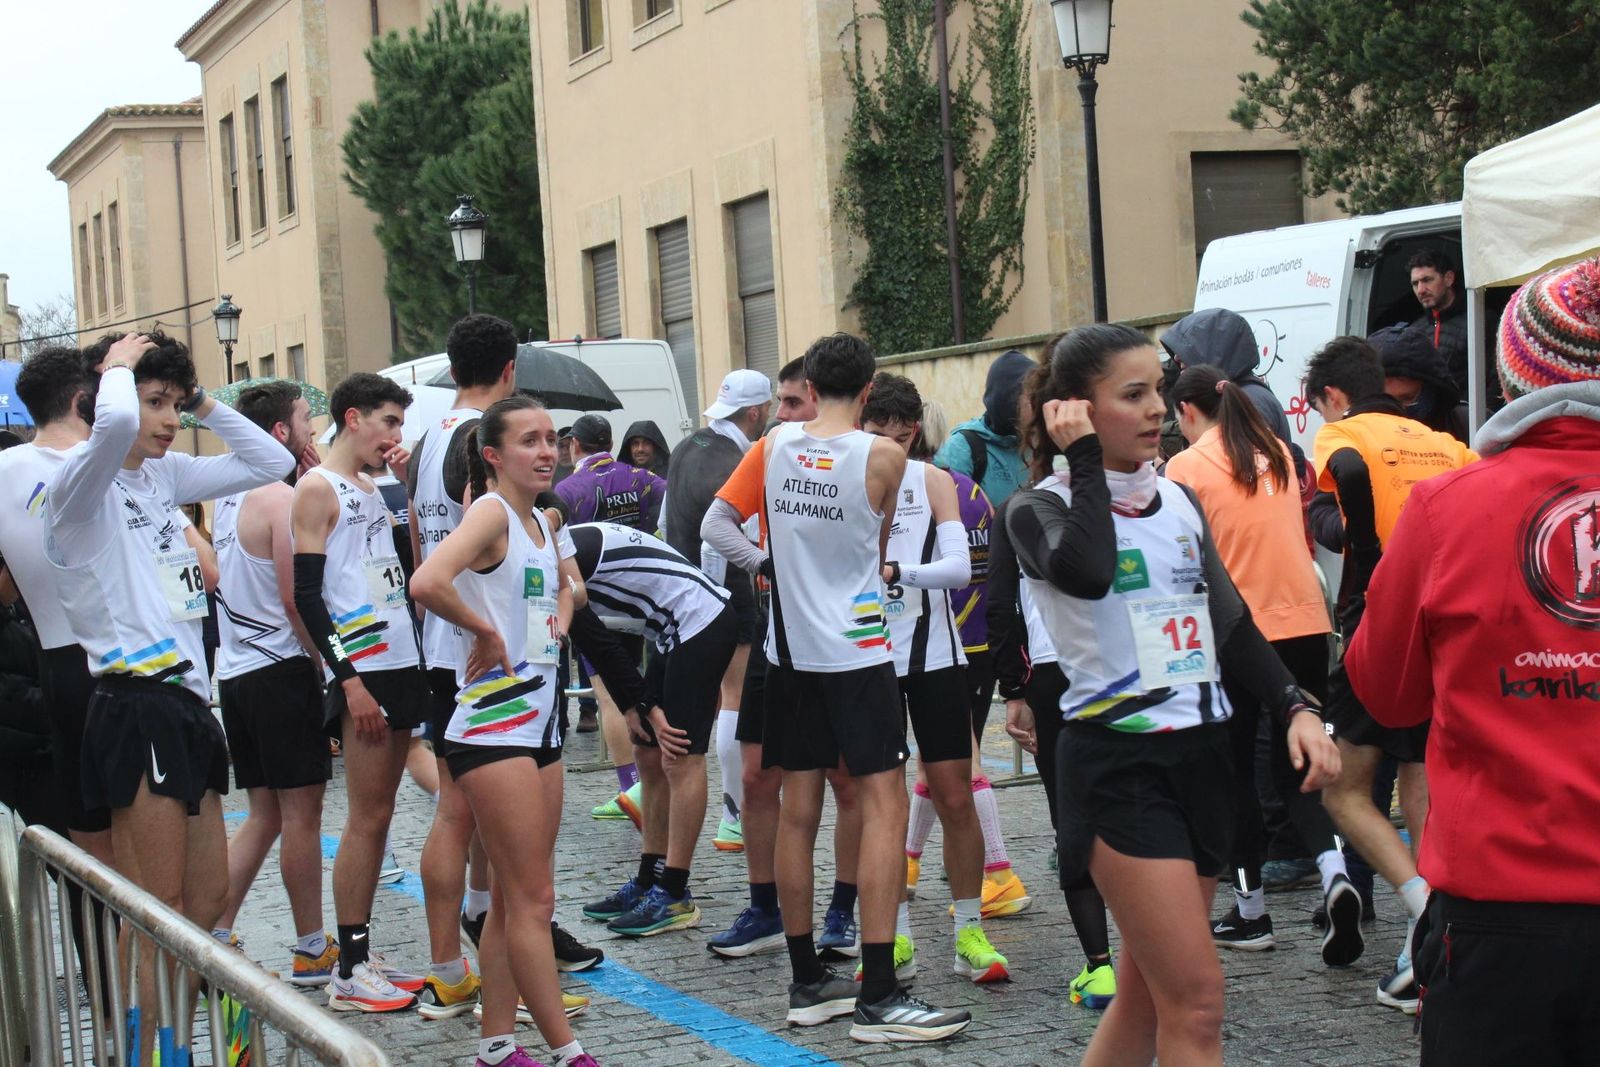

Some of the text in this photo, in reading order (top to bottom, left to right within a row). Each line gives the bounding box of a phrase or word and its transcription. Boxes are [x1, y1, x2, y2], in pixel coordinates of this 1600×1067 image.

[1200, 275, 1232, 295] Animación
[1233, 269, 1254, 285] bodas
[1261, 258, 1303, 278] comuniones
[1306, 270, 1331, 289] Talleres
[783, 478, 838, 498] ATLÉTICO
[775, 499, 844, 521] SALAMANCA
[179, 564, 204, 593] 18
[383, 566, 404, 588] 13
[1162, 615, 1202, 651] 12
[328, 633, 348, 662] SPIUK
